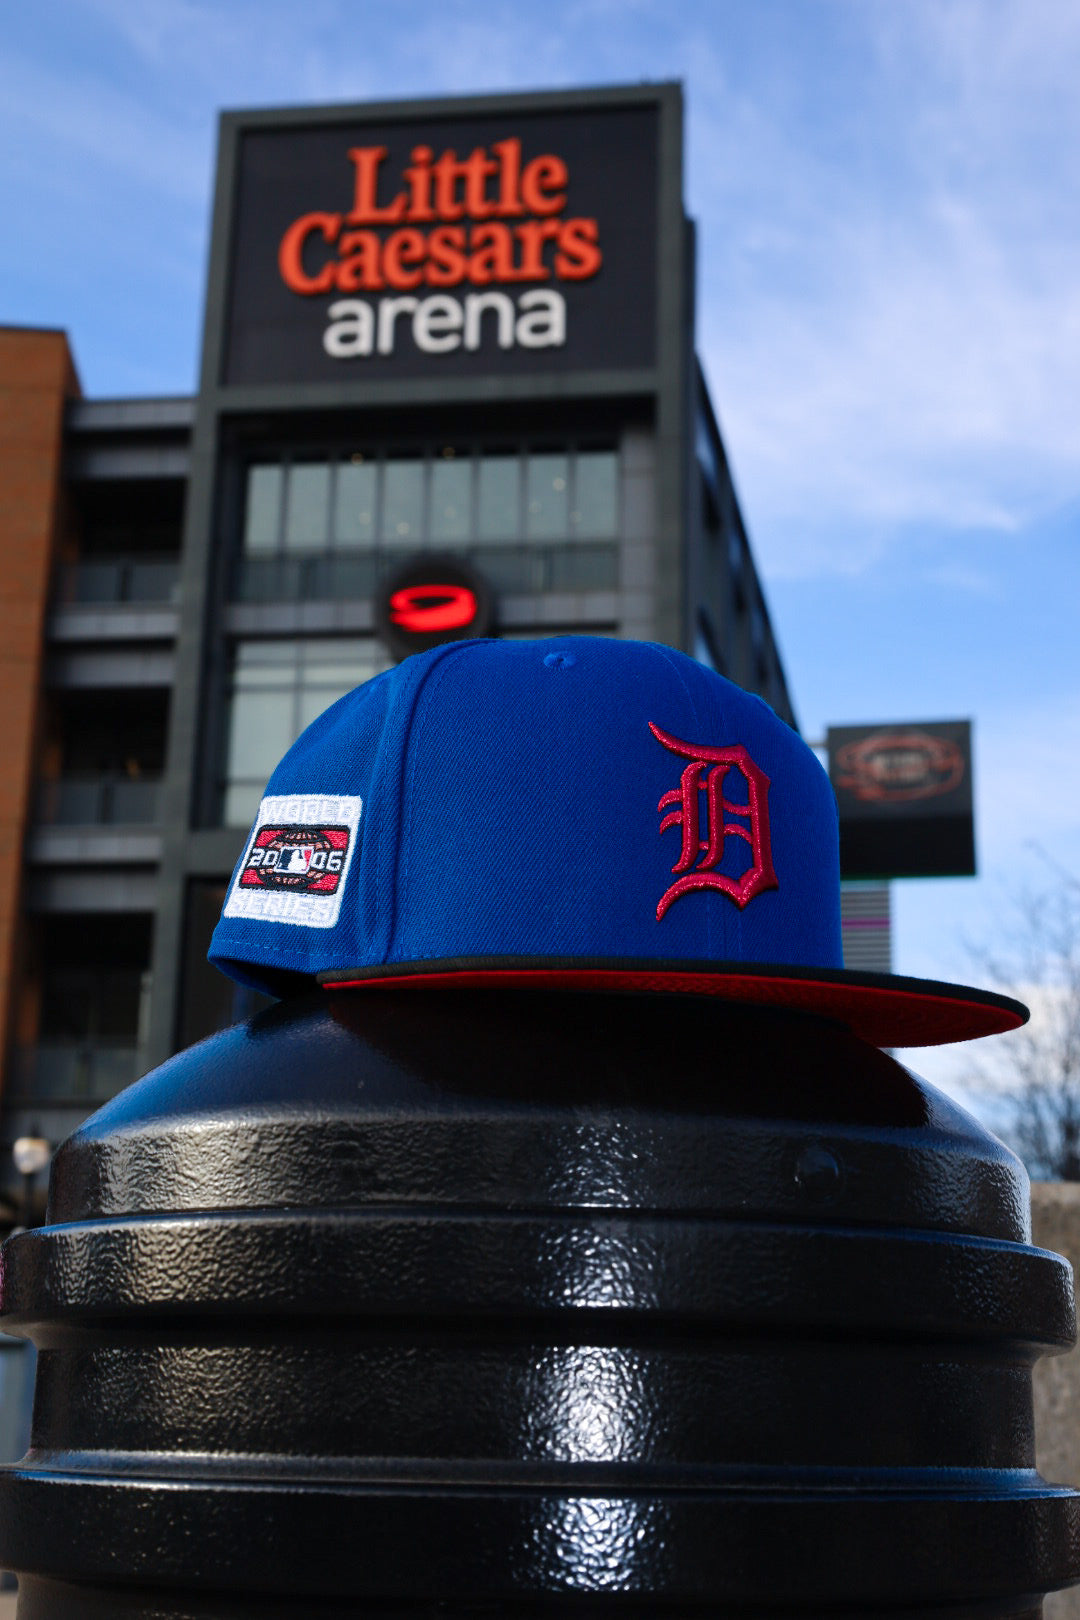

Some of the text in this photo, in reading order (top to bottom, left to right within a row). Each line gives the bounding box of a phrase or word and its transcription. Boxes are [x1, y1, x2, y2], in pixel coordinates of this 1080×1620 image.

[347, 137, 569, 226] Little
[278, 217, 602, 295] Caesars
[323, 288, 567, 358] arena
[262, 801, 355, 824] WORLD
[648, 721, 779, 922] D
[229, 892, 333, 921] SERIES
